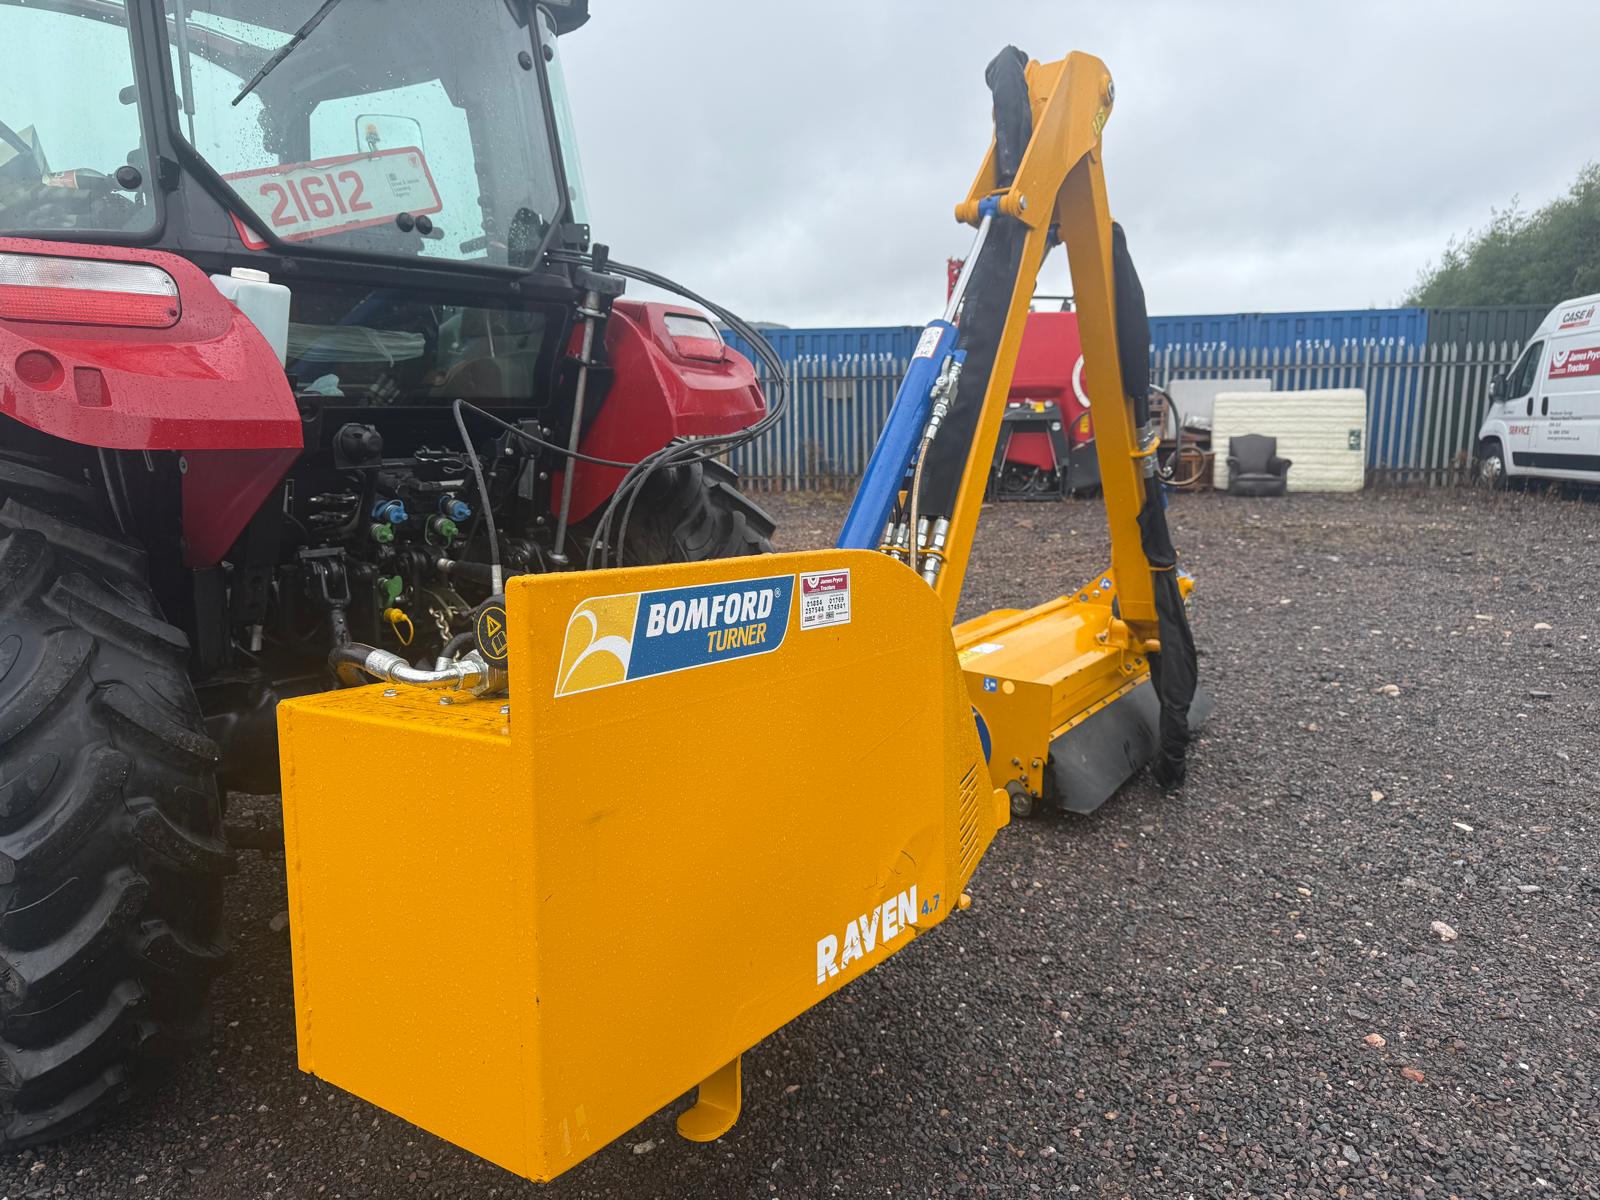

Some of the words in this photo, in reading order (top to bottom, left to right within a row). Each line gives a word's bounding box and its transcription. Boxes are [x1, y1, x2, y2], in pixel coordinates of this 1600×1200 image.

[259, 170, 373, 227] 21612
[1562, 310, 1587, 323] CASE
[1568, 352, 1587, 362] James
[1587, 350, 1600, 362] Pryc
[1567, 363, 1590, 374] Tractors
[1508, 425, 1531, 436] SERVICE
[708, 622, 767, 653] TURNER
[817, 884, 918, 985] RAVEN
[921, 893, 941, 916] 4.7
